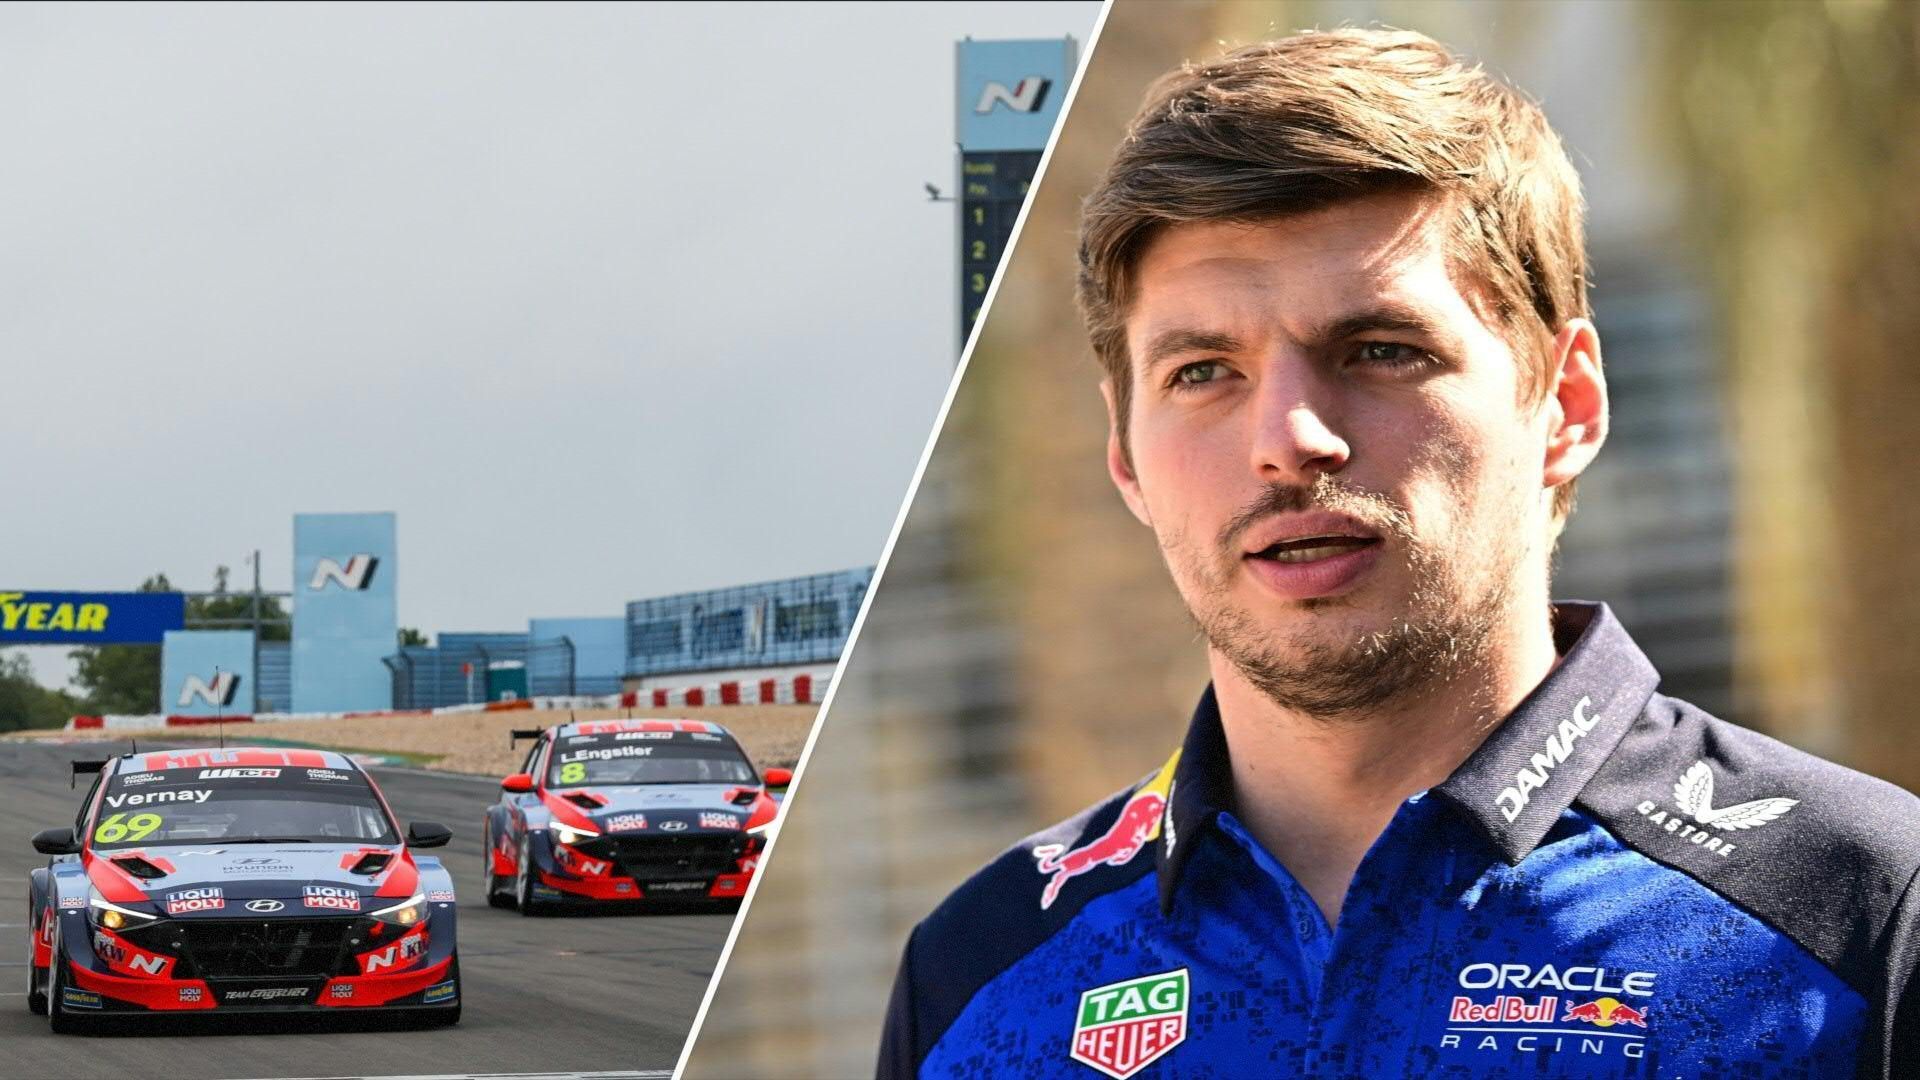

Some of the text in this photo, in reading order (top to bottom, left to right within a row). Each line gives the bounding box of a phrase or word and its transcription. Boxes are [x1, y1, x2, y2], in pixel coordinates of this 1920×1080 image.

[973, 207, 984, 226] 1
[971, 240, 986, 260] 2
[971, 272, 986, 293] 3
[1495, 695, 1600, 823] DAMAC
[199, 768, 282, 779] WTCR
[560, 763, 586, 784] 8
[106, 789, 213, 808] Vernay
[95, 813, 163, 843] 69
[1637, 800, 1738, 858] CASTORE
[169, 888, 222, 902] LIQUI
[306, 886, 356, 899] LIQUI
[306, 896, 359, 910] MOLY
[170, 899, 223, 913] MOLY
[1459, 962, 1658, 997] ORACLE
[225, 991, 250, 999] TEAM
[1089, 980, 1178, 1021] TAG
[1449, 996, 1558, 1023] Red Bull
[1077, 1019, 1179, 1071] HEUER
[1440, 1034, 1645, 1058] RACING
